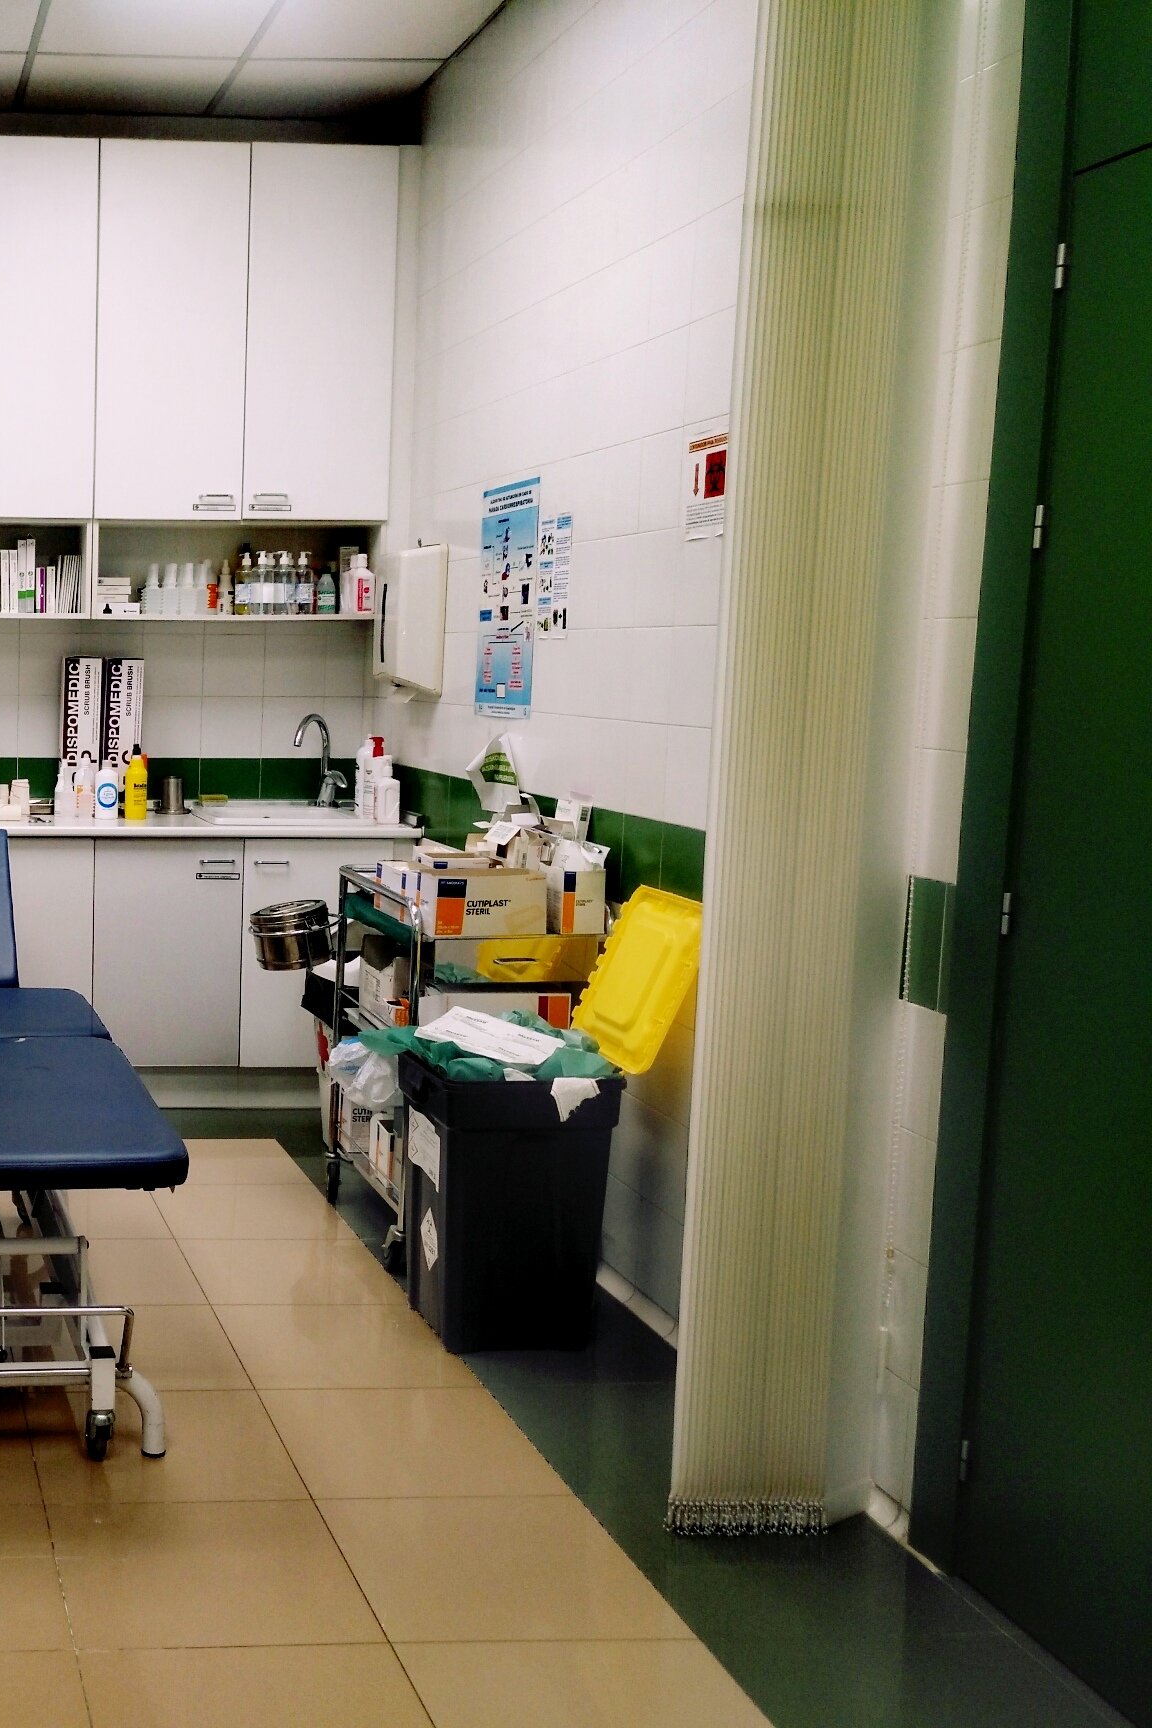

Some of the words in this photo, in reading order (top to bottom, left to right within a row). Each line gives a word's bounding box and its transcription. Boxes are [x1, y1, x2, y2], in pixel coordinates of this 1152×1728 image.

[66, 662, 80, 764] DISPOMEDIC
[108, 663, 122, 764] DISPOMEDIC
[465, 907, 491, 916] STERIL
[466, 899, 509, 908] CUTIPLAST
